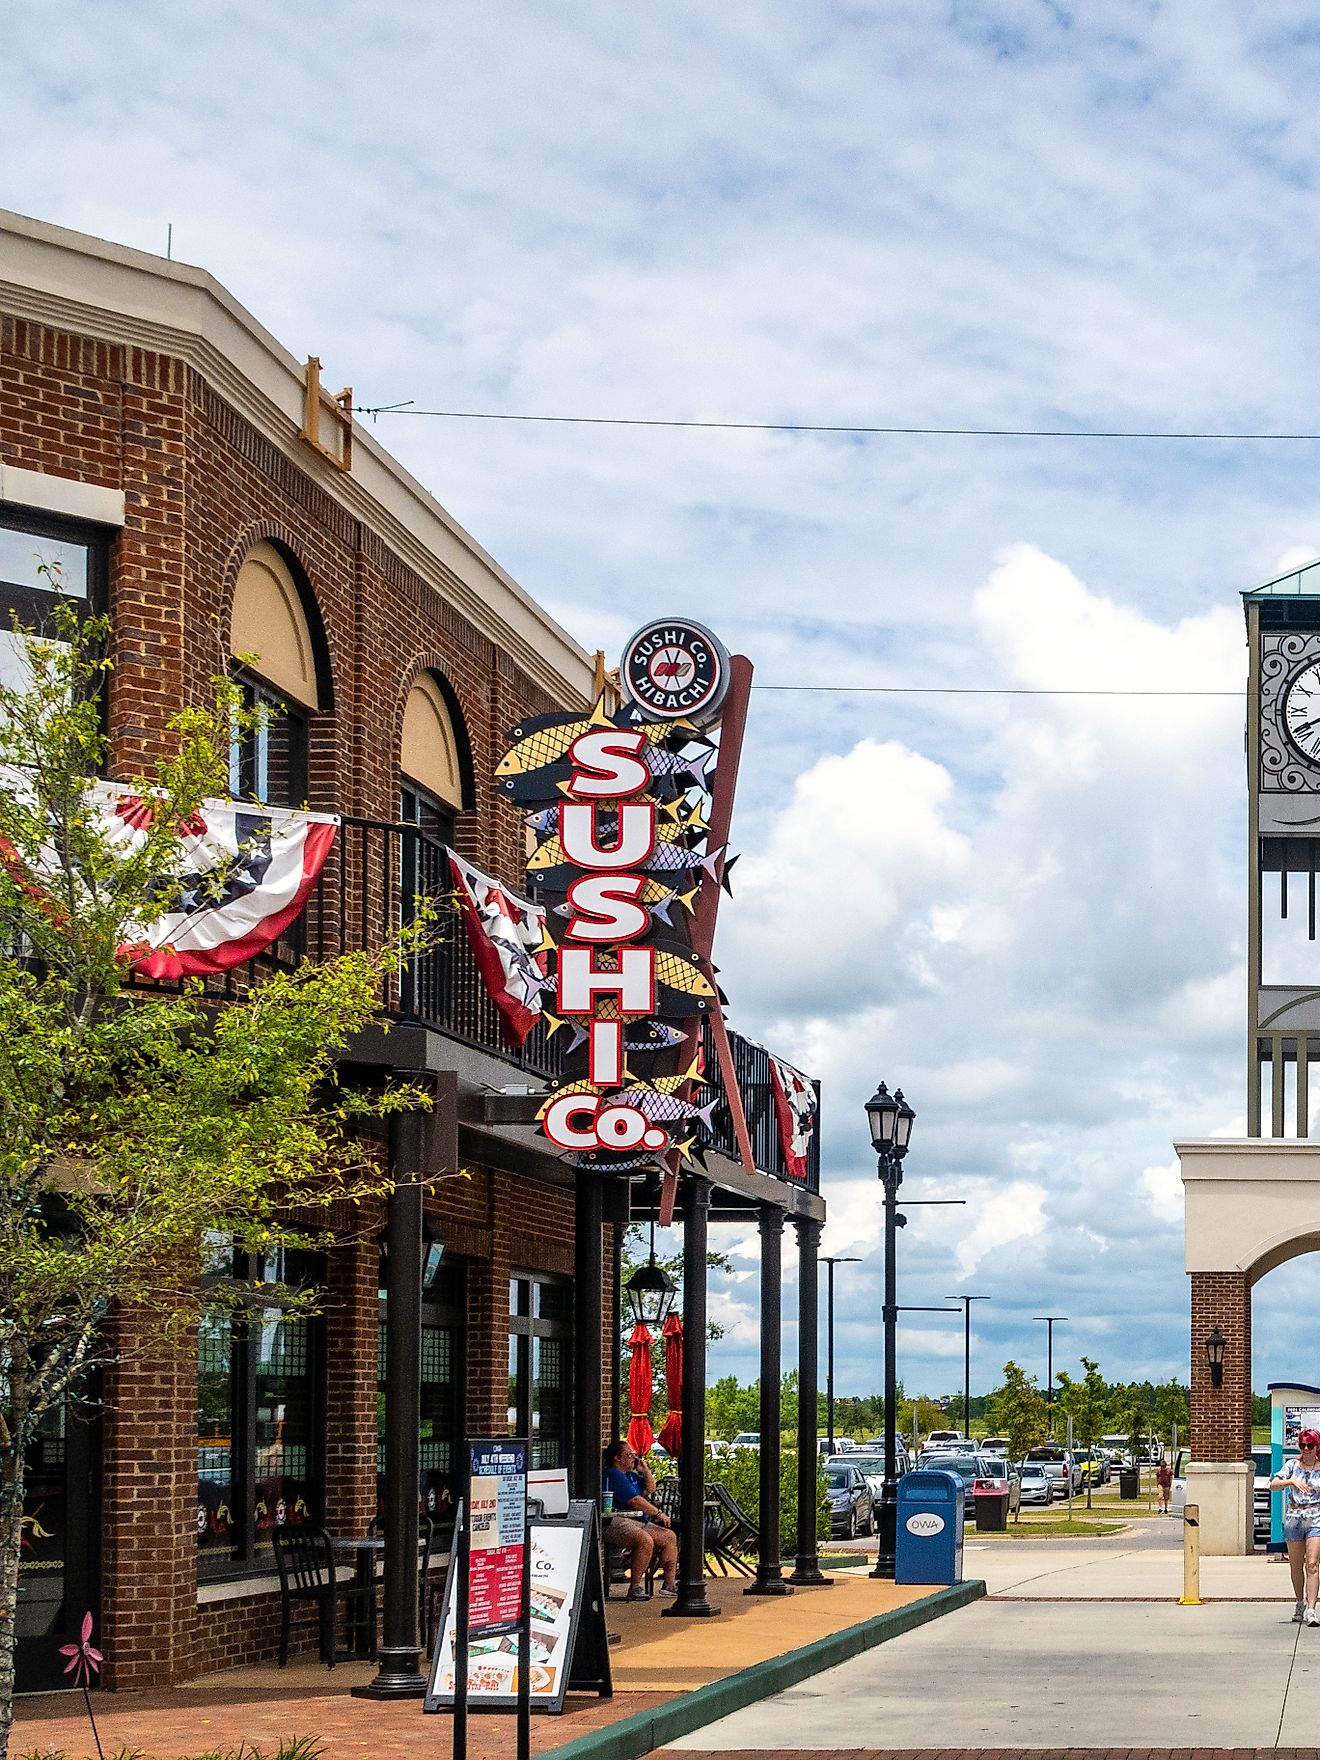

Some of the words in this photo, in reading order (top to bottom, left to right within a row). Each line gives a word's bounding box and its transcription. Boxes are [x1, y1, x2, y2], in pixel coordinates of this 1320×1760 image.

[634, 630, 686, 666] SUSHI
[690, 641, 707, 669] Co.
[635, 677, 709, 708] HIBACHI
[557, 730, 655, 1087] SUSHI
[543, 1092, 668, 1152] Co.
[912, 1521, 938, 1529] OWA
[536, 1560, 554, 1570] Co.
